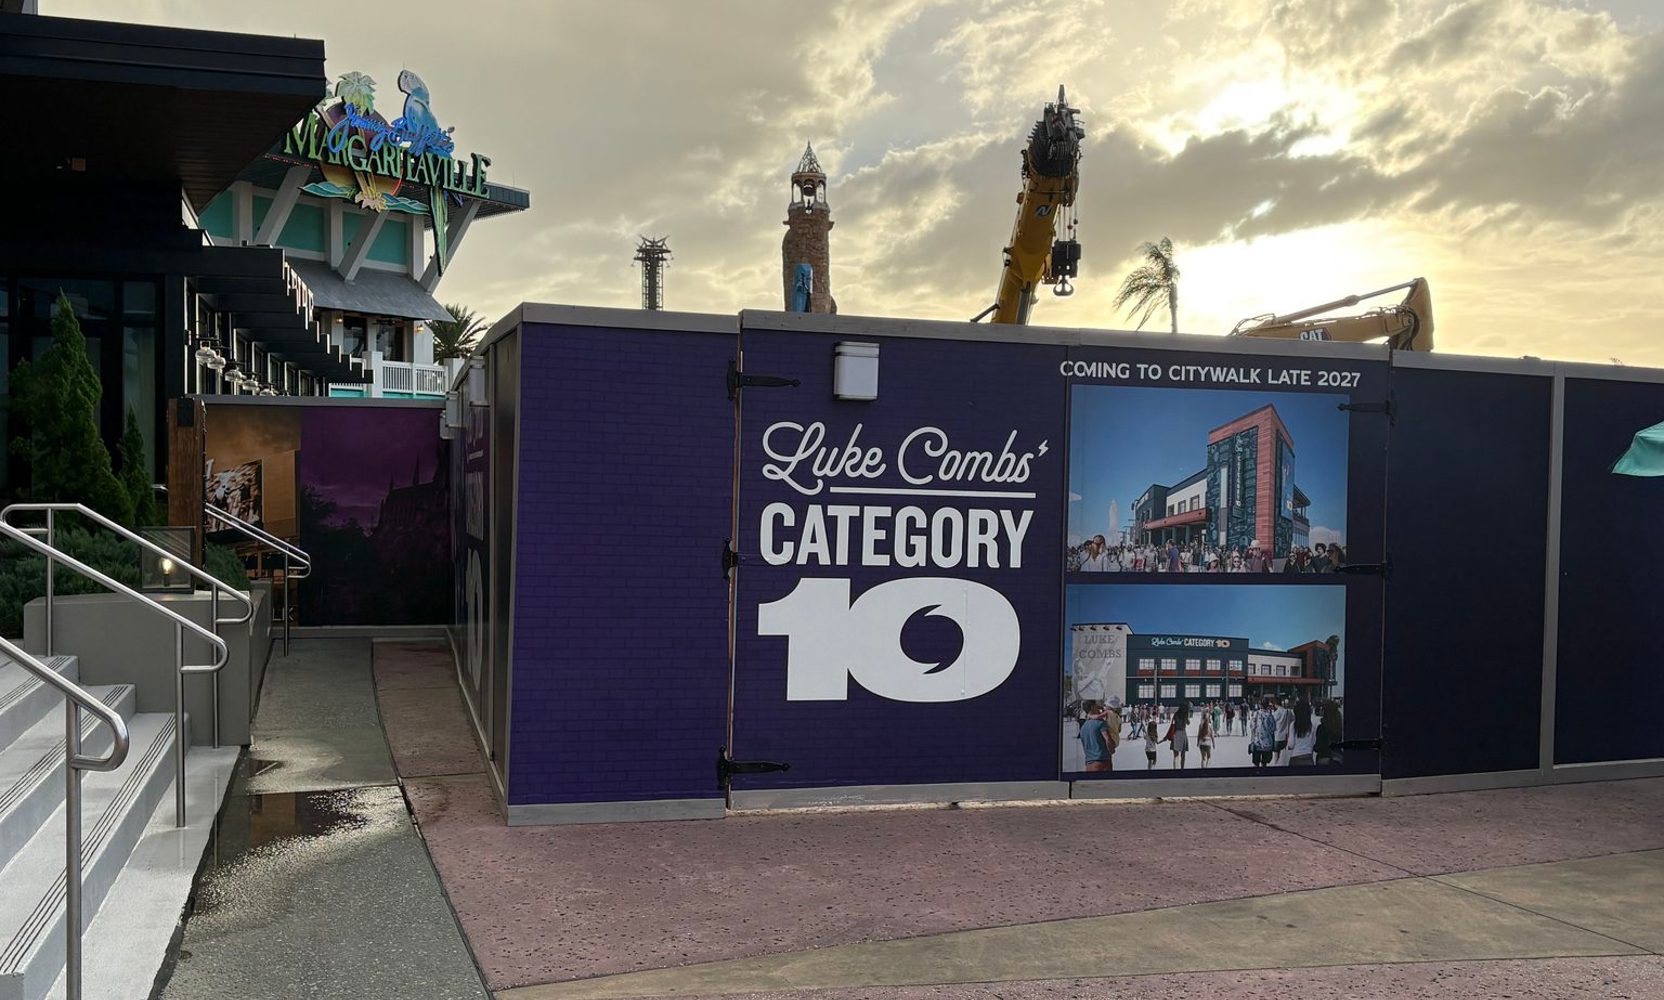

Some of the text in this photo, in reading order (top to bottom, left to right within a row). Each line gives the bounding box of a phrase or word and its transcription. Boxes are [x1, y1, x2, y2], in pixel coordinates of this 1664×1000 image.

[1299, 328, 1325, 342] CAT
[1060, 360, 1361, 388] COMING TO CITYWALK LATE 2027
[762, 421, 886, 496] Luke
[759, 502, 1034, 568] CATEGORY
[757, 577, 1021, 703] 10
[1083, 634, 1116, 645] LUKE
[1183, 638, 1215, 648] CATEGORY
[1078, 649, 1123, 659] COMBS
